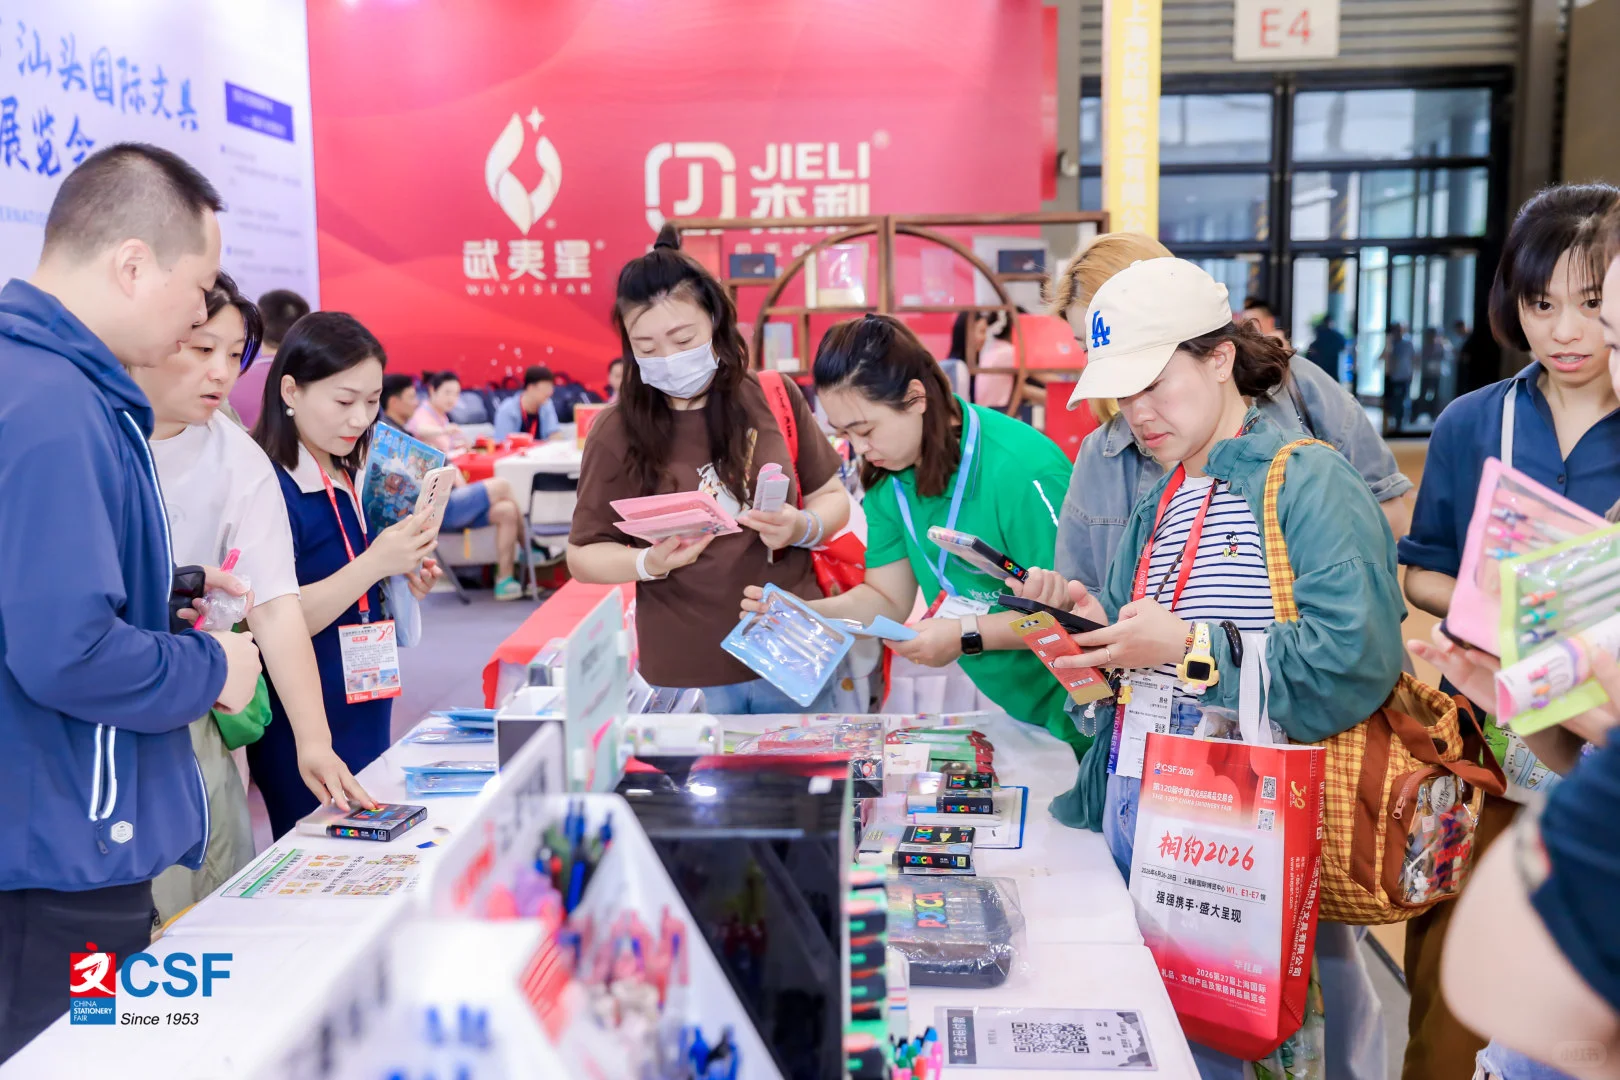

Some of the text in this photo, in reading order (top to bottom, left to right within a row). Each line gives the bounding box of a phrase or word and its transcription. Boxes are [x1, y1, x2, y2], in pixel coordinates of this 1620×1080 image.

[1258, 8, 1313, 48] E4
[16, 18, 199, 133] 汕头国际文具
[749, 141, 871, 181] JIELI
[1091, 310, 1111, 349] LA
[1161, 763, 1194, 777] CSF 2026
[335, 827, 360, 839] POSCA
[1156, 830, 1256, 872] 相约2026
[905, 854, 934, 865] POSCA
[1155, 890, 1243, 924] 强强携手·盛大呈现
[1196, 967, 1267, 993] 2026第27届上海国际
